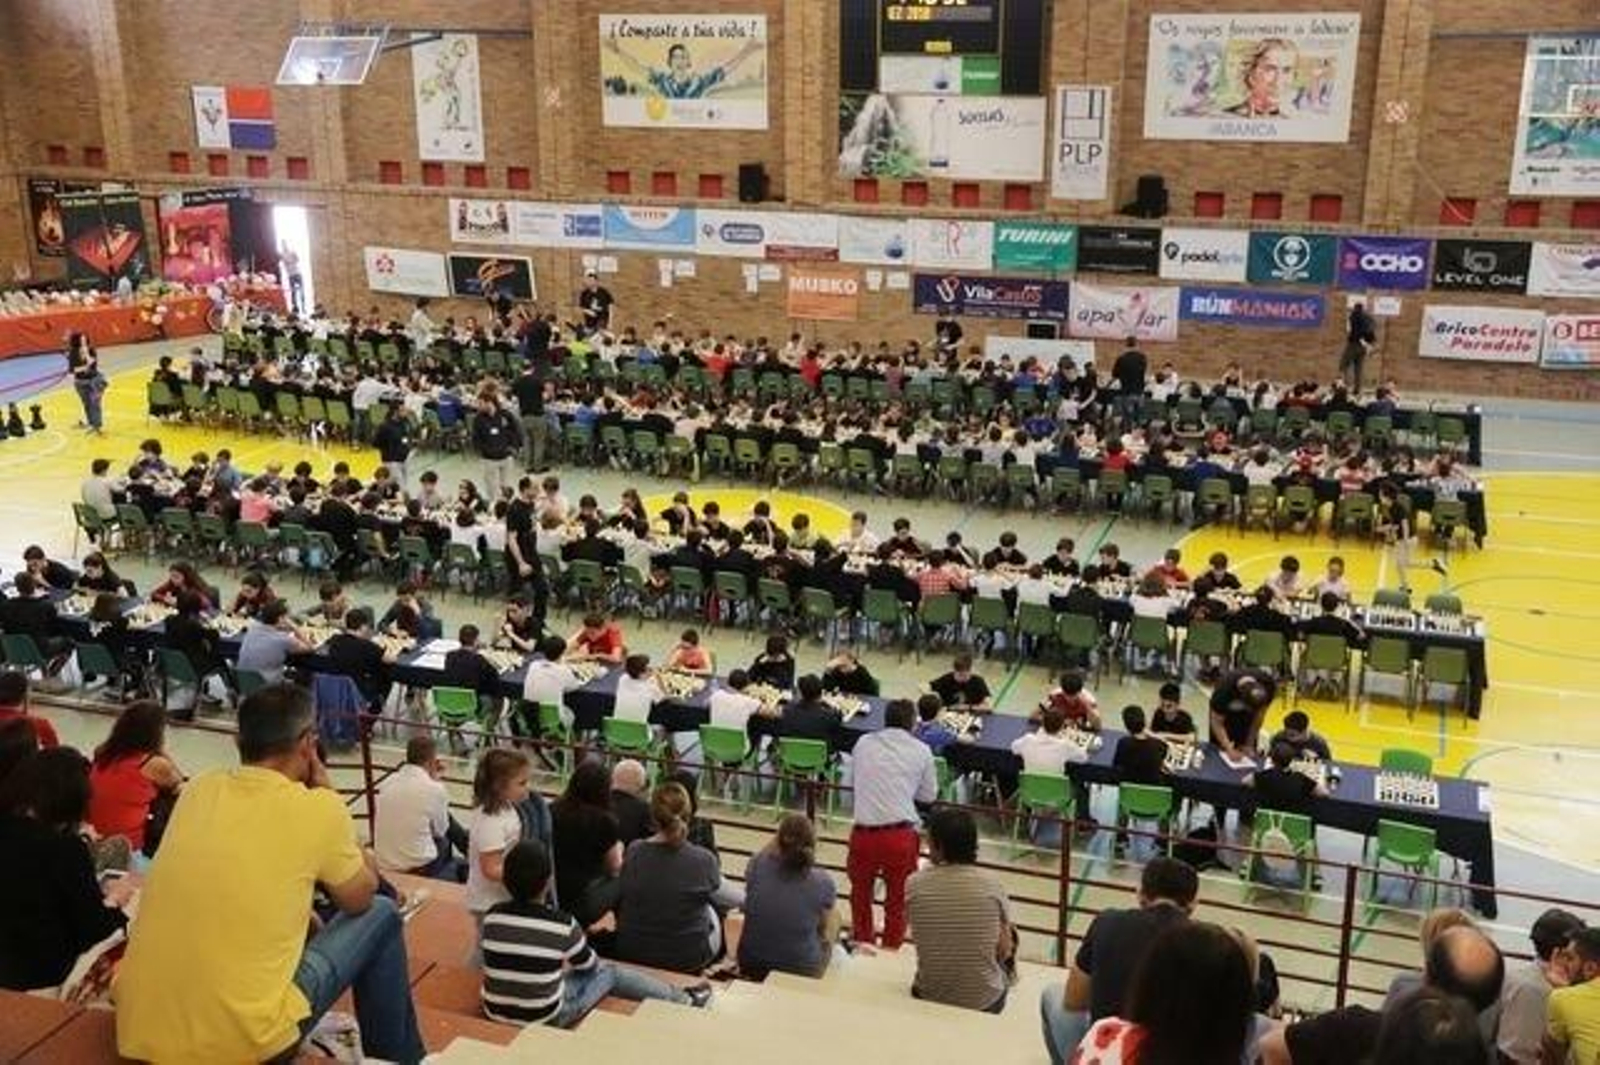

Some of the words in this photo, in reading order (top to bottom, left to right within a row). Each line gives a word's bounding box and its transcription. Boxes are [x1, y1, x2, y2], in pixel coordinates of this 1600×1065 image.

[1060, 143, 1102, 165] PLP
[999, 228, 1074, 246] TURINI
[1360, 253, 1424, 273] OCHO
[1435, 273, 1483, 286] LEVEL
[1488, 274, 1526, 286] ONE
